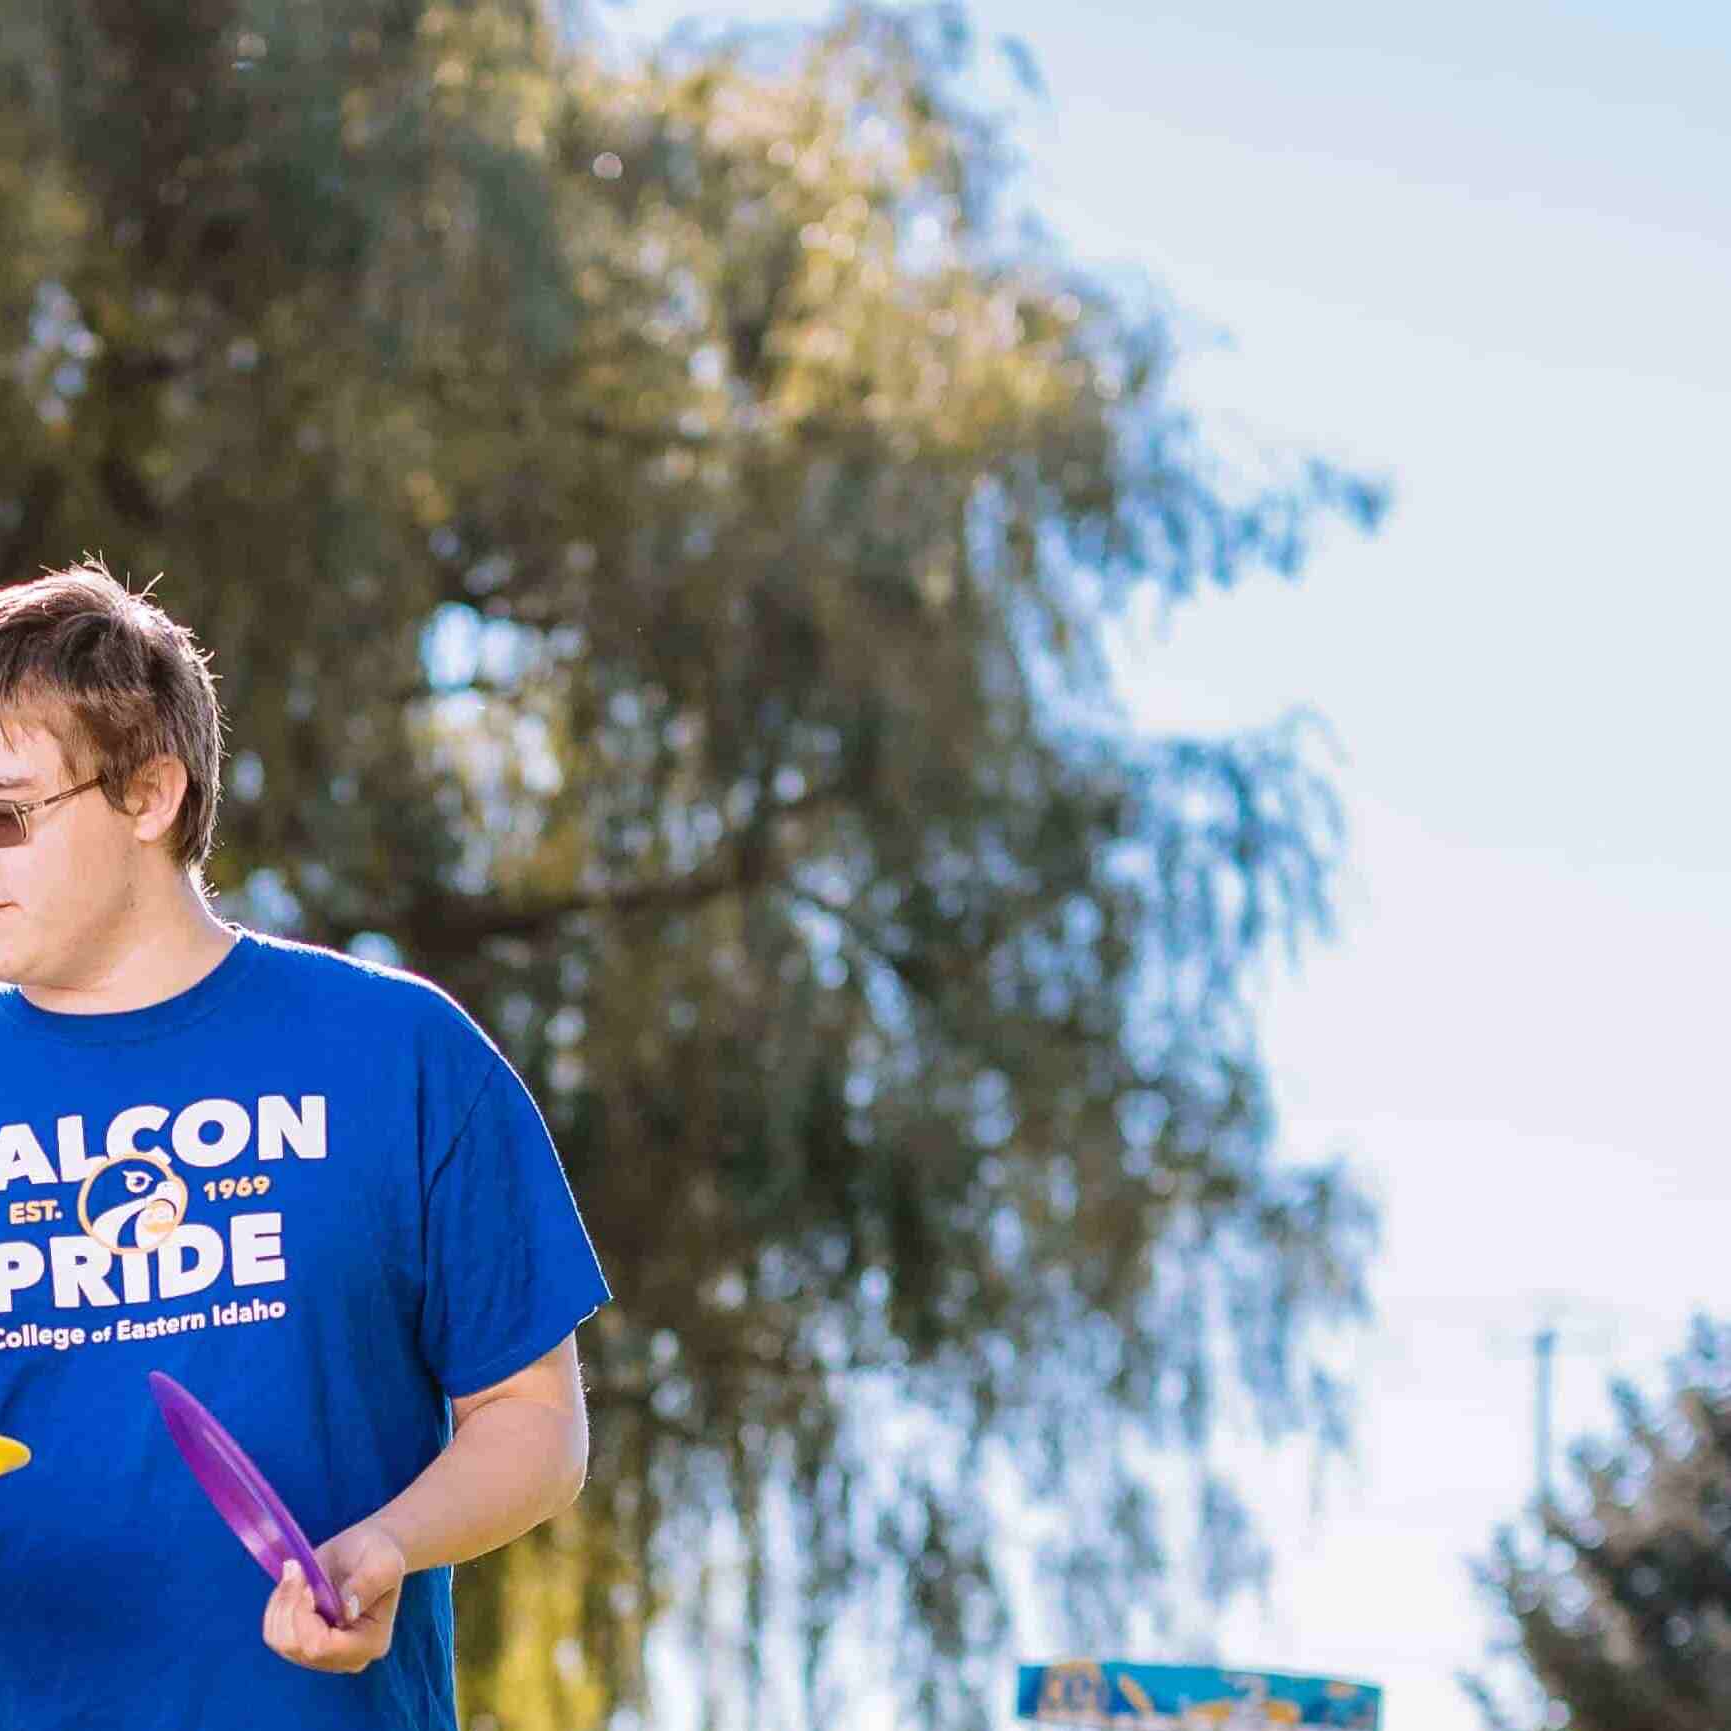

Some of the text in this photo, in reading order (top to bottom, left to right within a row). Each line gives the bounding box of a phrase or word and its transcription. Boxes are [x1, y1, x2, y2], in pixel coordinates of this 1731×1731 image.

[9, 1175, 271, 1225] EST. 1969
[91, 1325, 112, 1344] of
[116, 1312, 206, 1342] Eastern
[212, 1298, 287, 1327] Idaho
